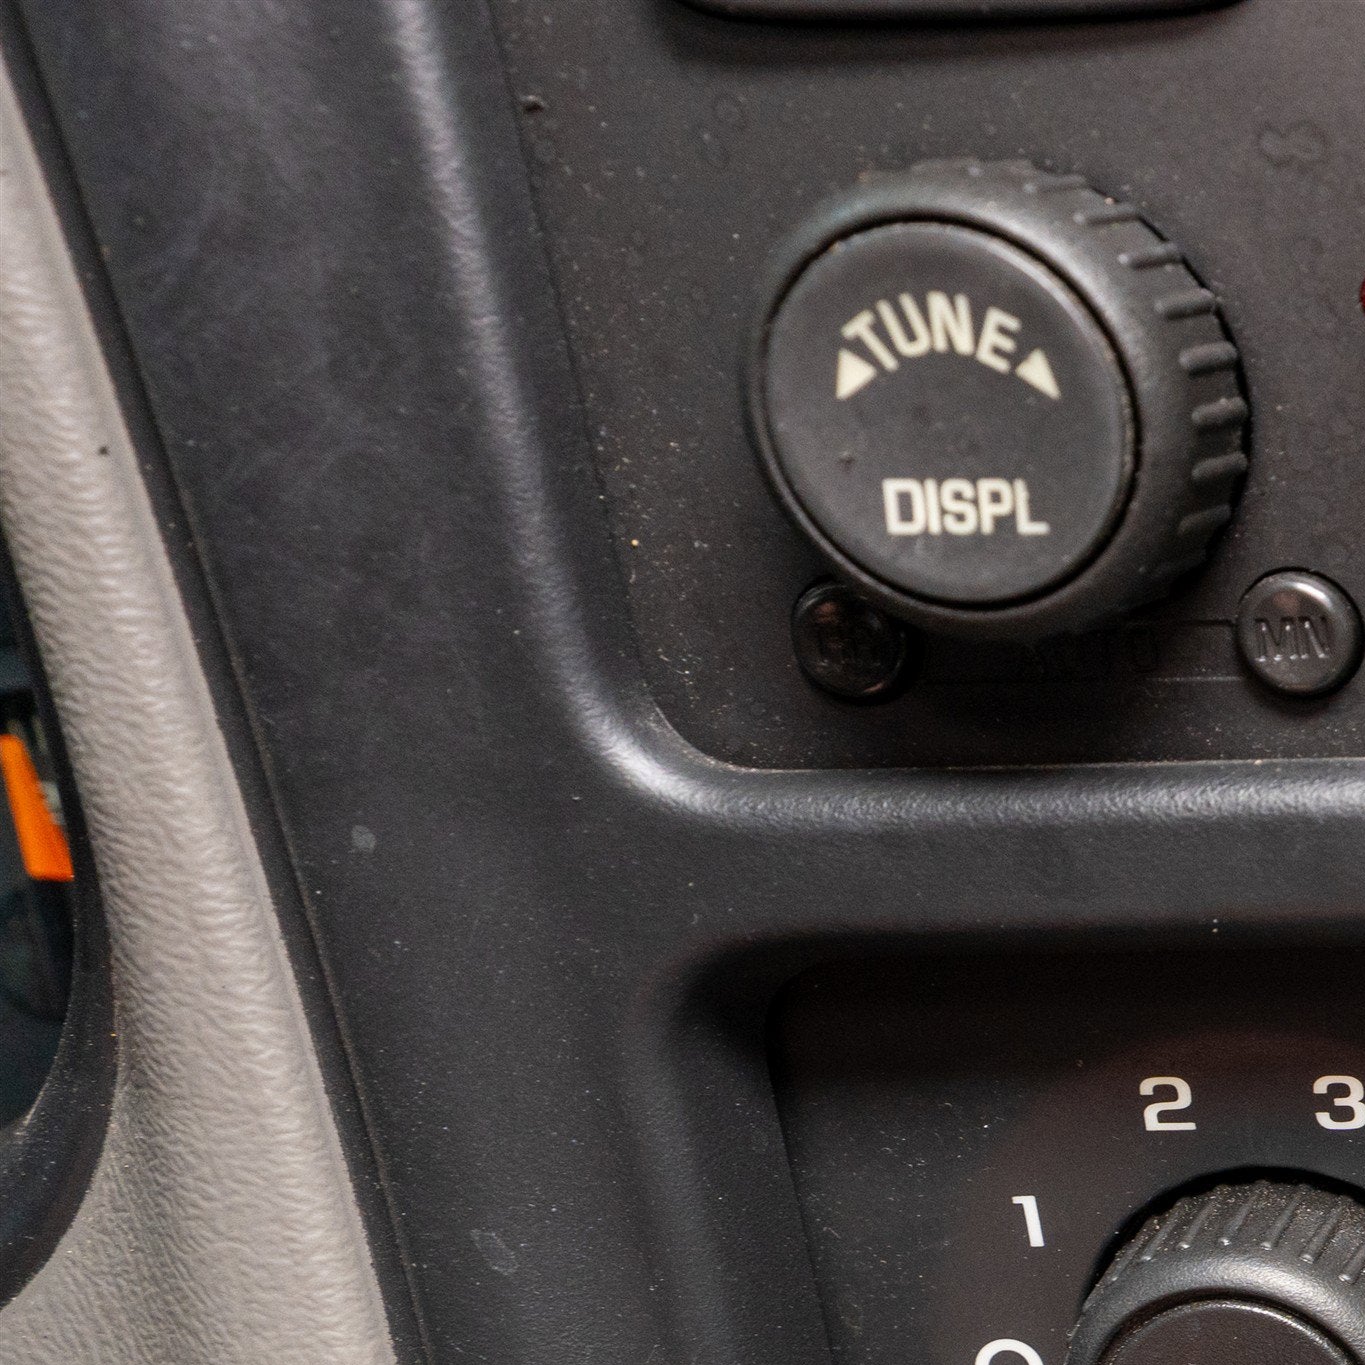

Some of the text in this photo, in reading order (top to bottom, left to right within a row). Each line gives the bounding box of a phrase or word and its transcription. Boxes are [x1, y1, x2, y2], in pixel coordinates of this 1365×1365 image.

[841, 291, 1021, 372] TUNE
[882, 478, 1048, 536] DISPL
[1255, 616, 1331, 662] MN
[1138, 1075, 1198, 1132] 2
[1011, 1194, 1046, 1248] 1
